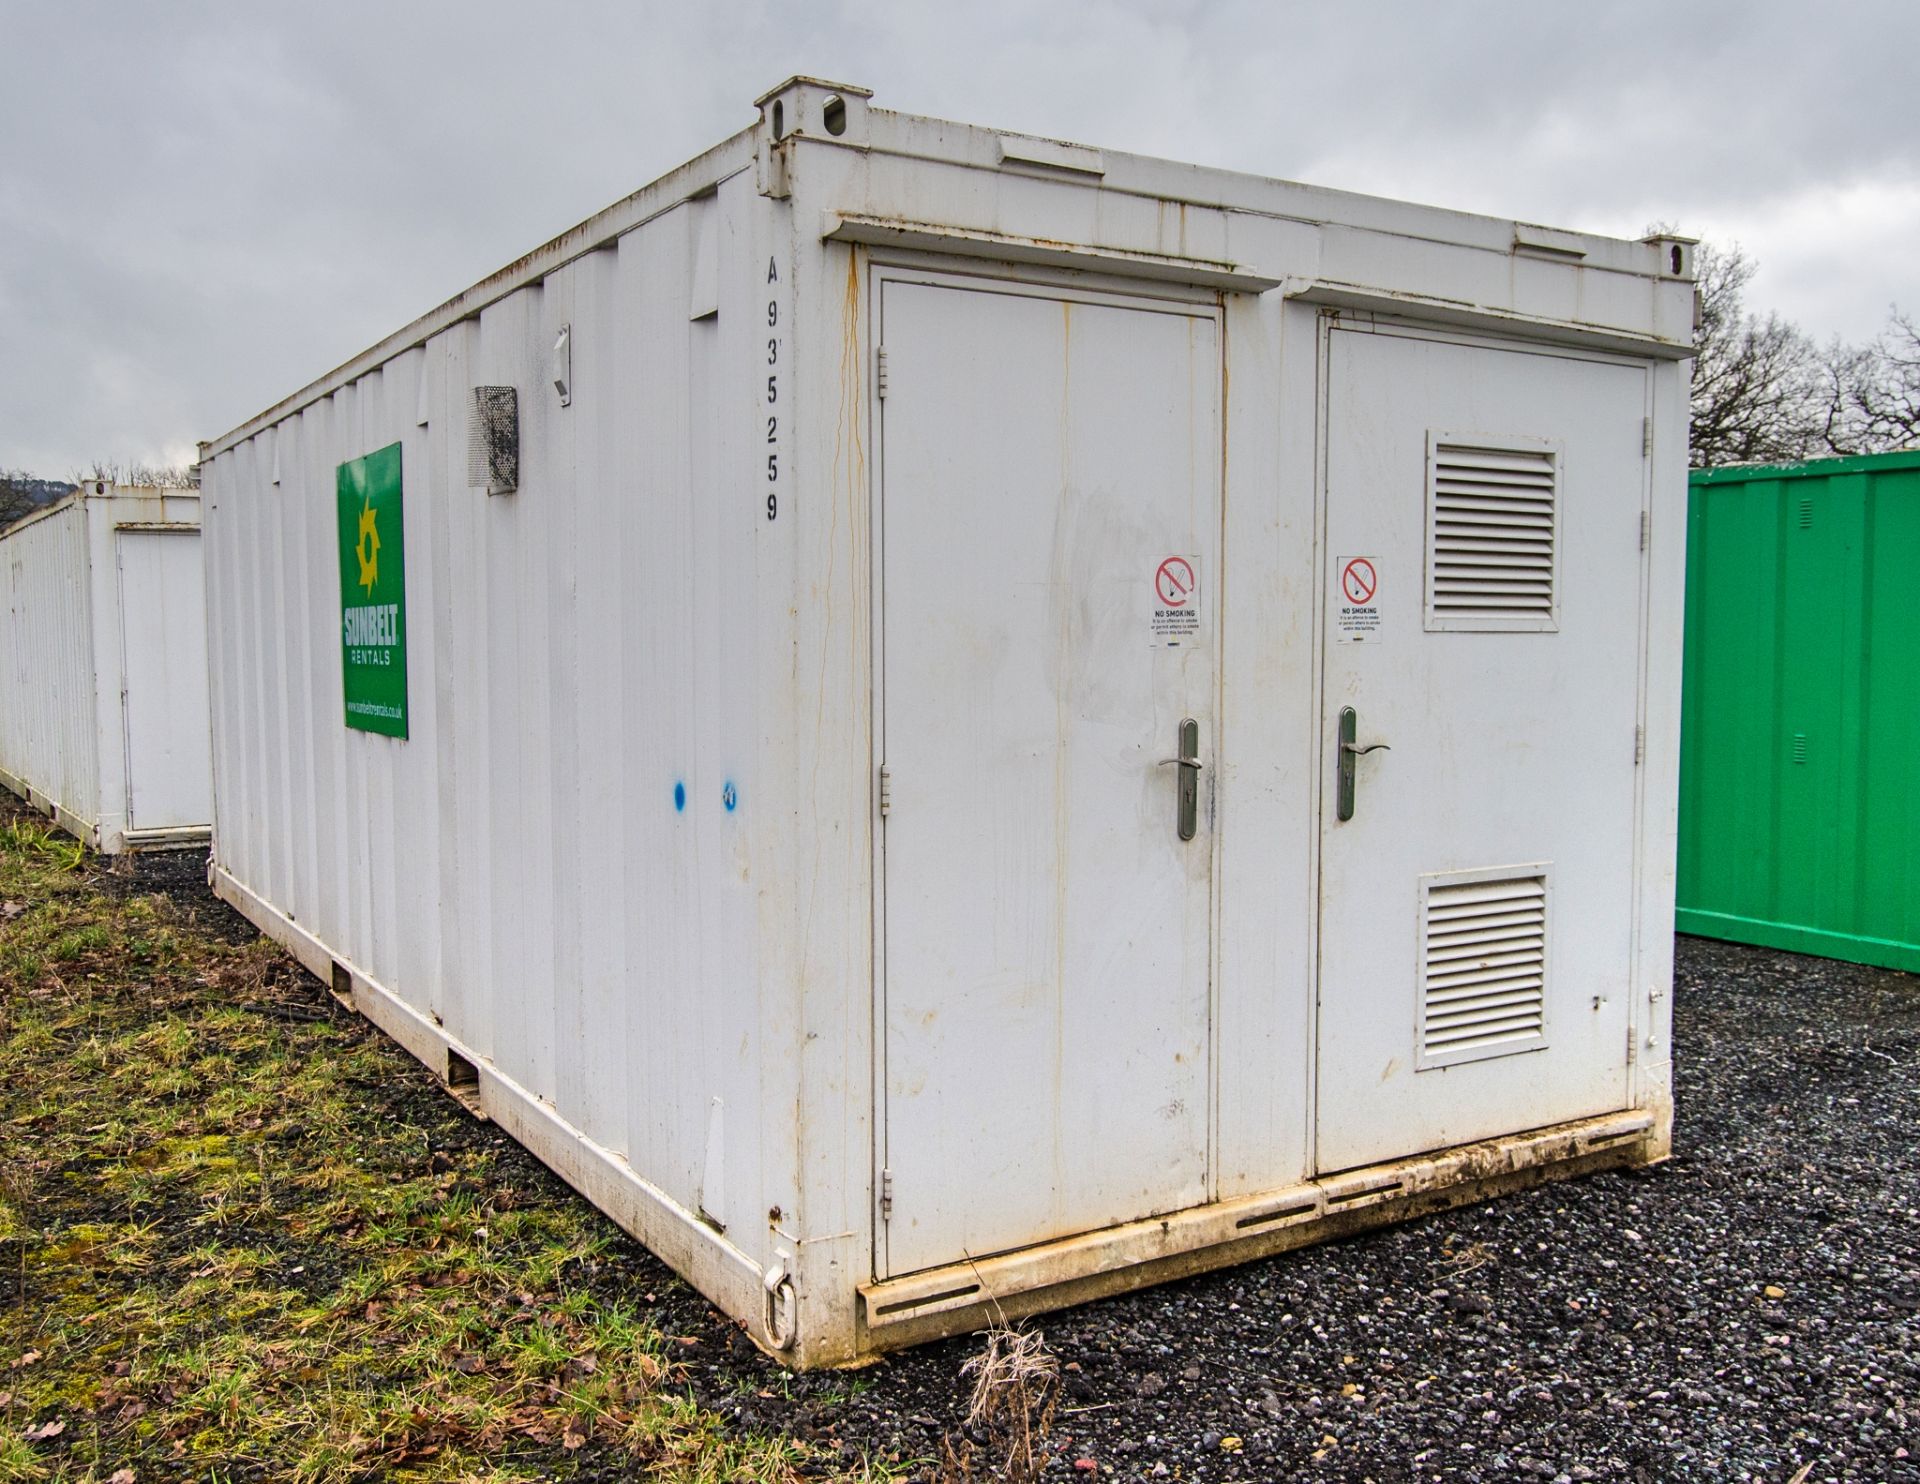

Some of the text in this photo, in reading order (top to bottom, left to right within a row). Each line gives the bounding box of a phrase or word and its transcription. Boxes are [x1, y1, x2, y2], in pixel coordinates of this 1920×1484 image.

[767, 255, 778, 521] A935259
[1165, 609, 1195, 617] SMOKING
[344, 603, 398, 646] SUNBELT
[351, 650, 390, 666] RENTALS
[347, 699, 402, 719] www.sunbeltrentals.co.uk
